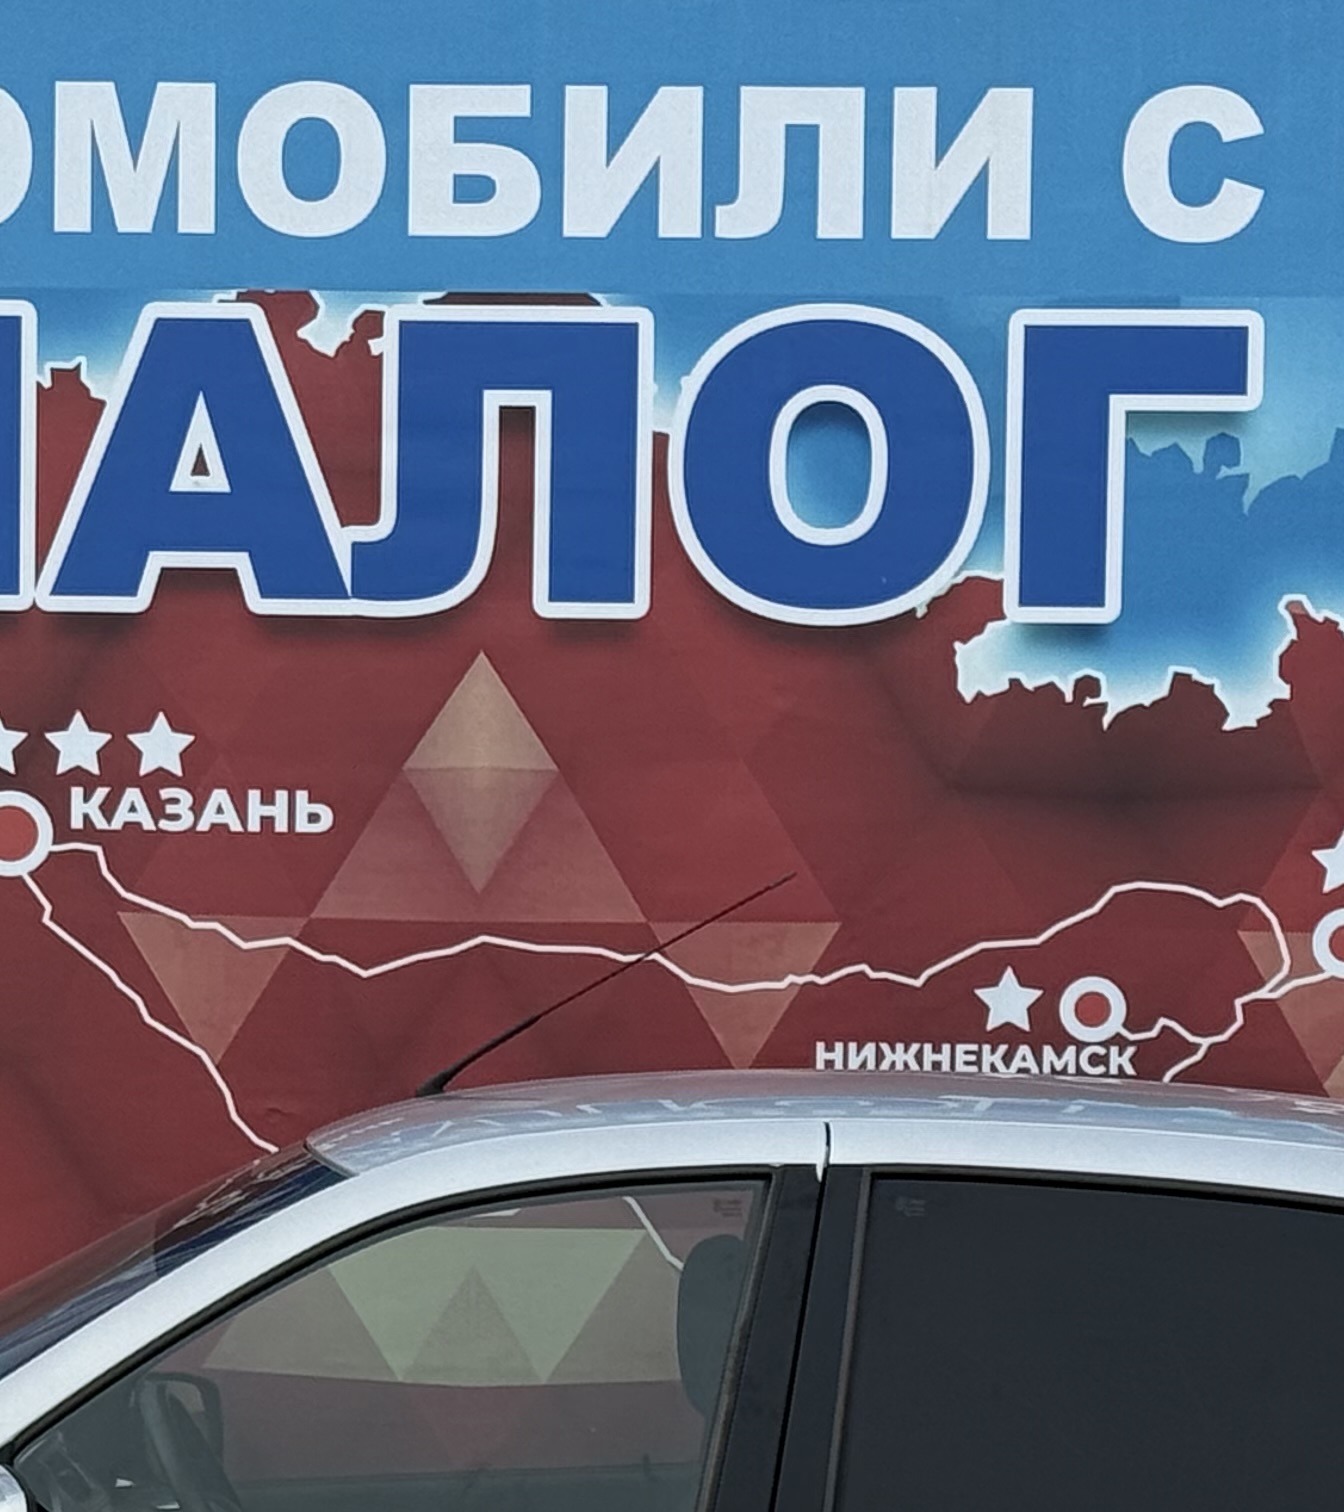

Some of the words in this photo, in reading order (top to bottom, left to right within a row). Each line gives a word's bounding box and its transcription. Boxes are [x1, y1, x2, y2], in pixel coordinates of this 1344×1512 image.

[1122, 84, 1267, 246] С
[70, 786, 335, 835] КАЗАНЬ
[814, 1040, 1138, 1077] НИЖНЕКАМСК
